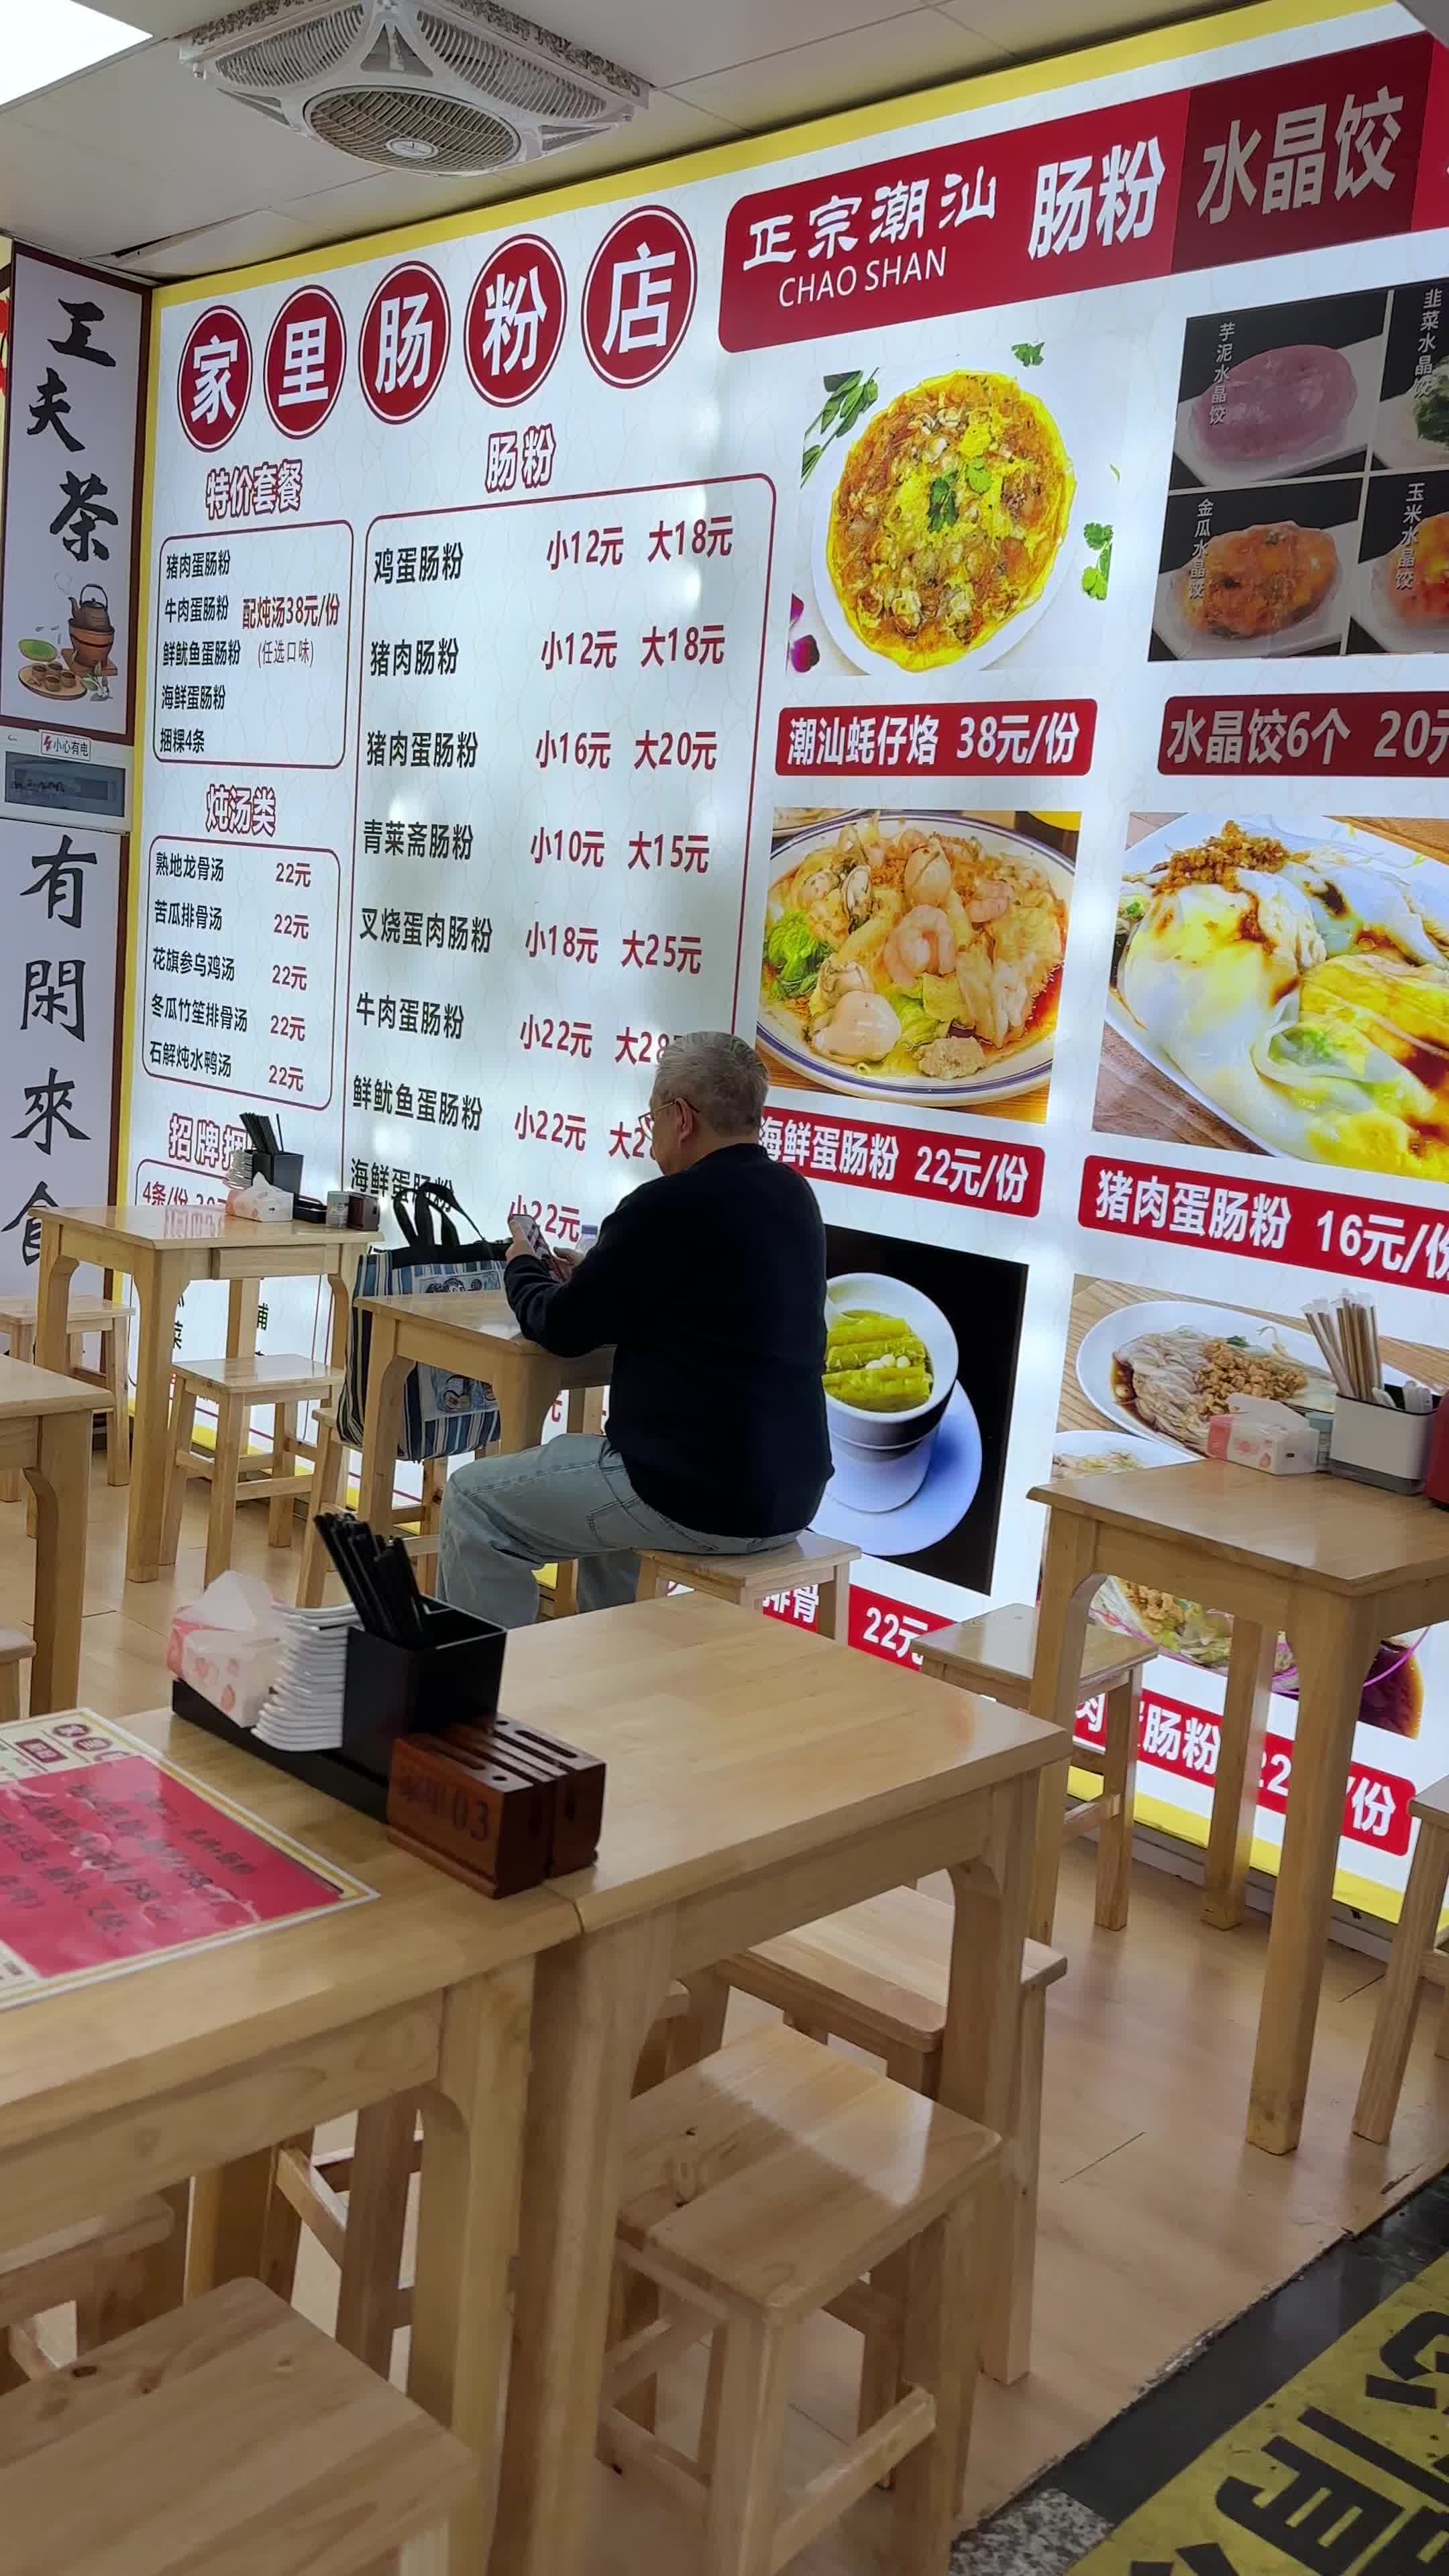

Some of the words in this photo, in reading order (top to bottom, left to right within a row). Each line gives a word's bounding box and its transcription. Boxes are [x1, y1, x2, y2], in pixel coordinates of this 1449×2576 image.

[1197, 85, 1404, 227] 水晶饺
[743, 166, 997, 272] 正宗潮汕
[1028, 135, 1167, 262] 肠粉
[779, 266, 857, 307] CHAO
[864, 246, 947, 291] SHAN
[191, 242, 676, 425] 家里肠粉店
[1412, 287, 1443, 400] 韭菜水晶饺
[1209, 322, 1236, 426] 芋泥水晶饺
[27, 297, 119, 561] 工夫茶
[485, 423, 557, 494] 肠粉
[205, 459, 303, 521] 特价套餐
[166, 549, 231, 580] 猪肉蛋肠粉
[374, 541, 464, 585] 鸡蛋肠粉
[546, 526, 624, 570] 小12元
[647, 515, 733, 564] 大18元
[1187, 498, 1214, 601] 金瓜水晶饺
[1395, 482, 1426, 590] 玉米水晶饺
[164, 594, 229, 623] 牛肉蛋肠粉
[241, 593, 340, 629] 配炖汤38元/份
[162, 639, 241, 666] 鲜鱿鱼蛋肠粉
[370, 637, 460, 677] 猪肉肠粉
[541, 630, 617, 670] 小12元
[641, 625, 726, 667] 大18元
[161, 684, 226, 710] 海鲜蛋肠粉
[53, 738, 89, 757] 小心有电
[366, 731, 478, 769] 猪肉蛋肠粉
[535, 730, 611, 769] 小16元
[634, 729, 717, 771] 大20元
[786, 714, 940, 765] 潮汕蚝仔烙
[956, 711, 1079, 765] 38元/份
[1165, 707, 1351, 766] 水晶饺6个
[206, 783, 276, 837] 炖汤类
[156, 851, 224, 882] 熟地龙骨汤
[275, 862, 312, 888] 22元
[530, 826, 605, 868] 小10元
[628, 831, 710, 873] 大15元
[154, 900, 223, 931] 苦瓜排骨汤
[274, 914, 309, 939] 22元
[359, 908, 494, 953] 叉烧蛋肉肠粉
[525, 921, 600, 964] 小18元
[621, 930, 703, 975] 大25元
[152, 946, 235, 982] 花旗参乌鸡汤
[272, 964, 308, 991] 22元
[151, 994, 248, 1032] 冬瓜竹笙排骨汤
[270, 1015, 306, 1041] 22元
[356, 992, 465, 1040] 牛肉蛋肠粉
[519, 1014, 592, 1059] 小22元
[614, 1026, 684, 1065] 大28
[268, 1065, 304, 1092] 22元
[168, 1113, 257, 1171] 招牌捆
[352, 1075, 483, 1132] 鲜鱿鱼蛋肠粉
[514, 1105, 587, 1152] 小22元
[758, 1116, 900, 1181] 海鲜蛋肠粉
[914, 1145, 1030, 1205] 22元/份
[1094, 1168, 1292, 1250] 猪肉蛋肠粉
